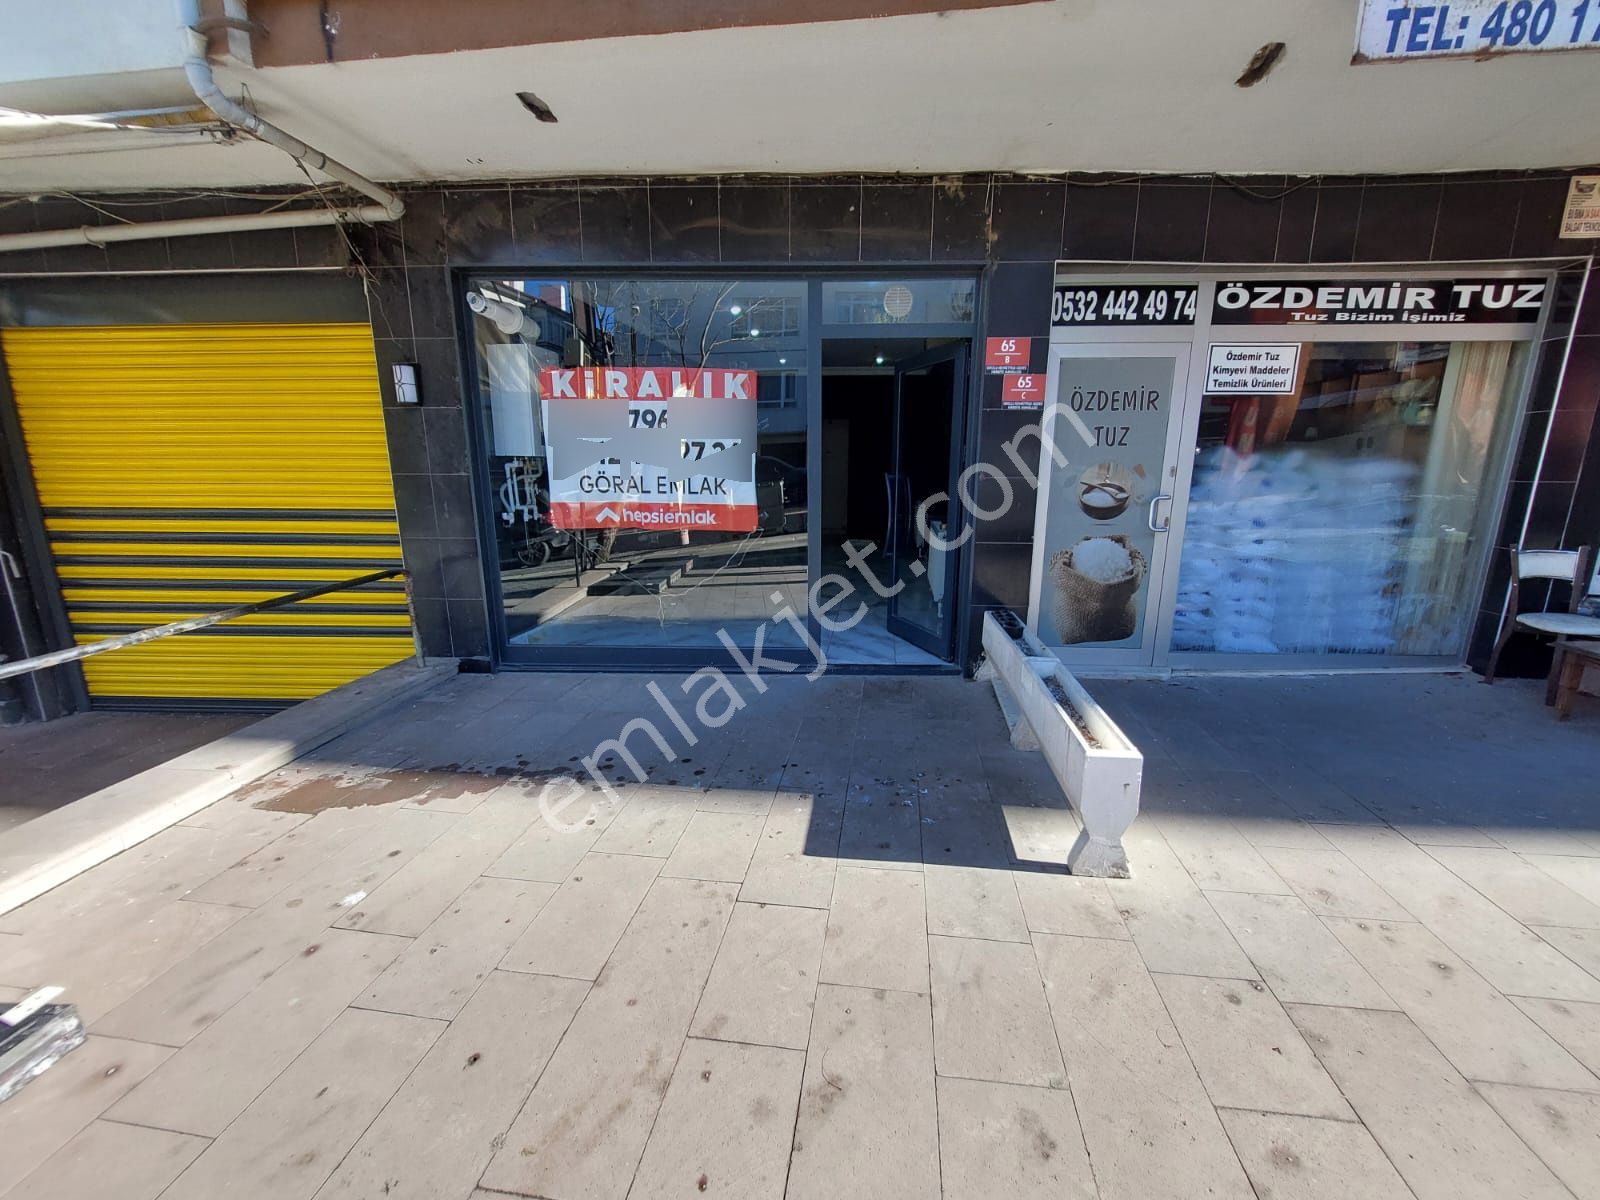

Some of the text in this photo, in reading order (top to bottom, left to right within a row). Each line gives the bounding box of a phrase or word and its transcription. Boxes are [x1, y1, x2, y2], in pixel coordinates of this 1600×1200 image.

[1386, 5, 1470, 53] TEL:
[1480, 0, 1557, 47] 480
[1217, 282, 1546, 310] ÖZDEMİR TUZ
[1052, 290, 1197, 321] 0532 442 49 74
[1291, 312, 1329, 321] Tuz
[1335, 312, 1394, 321] Bizim
[1001, 339, 1016, 352] 65
[1226, 350, 1280, 361] Özdemir Tuz
[1212, 366, 1291, 376] Kimyevi Maddeler
[1017, 376, 1032, 388] 65
[1213, 378, 1286, 388] Temizlik Ürünleri
[1070, 386, 1160, 412] ÖZDEMİR
[1094, 426, 1130, 447] TUZ
[579, 470, 651, 495] GÖRAL
[623, 509, 716, 525] hepsiemlak
